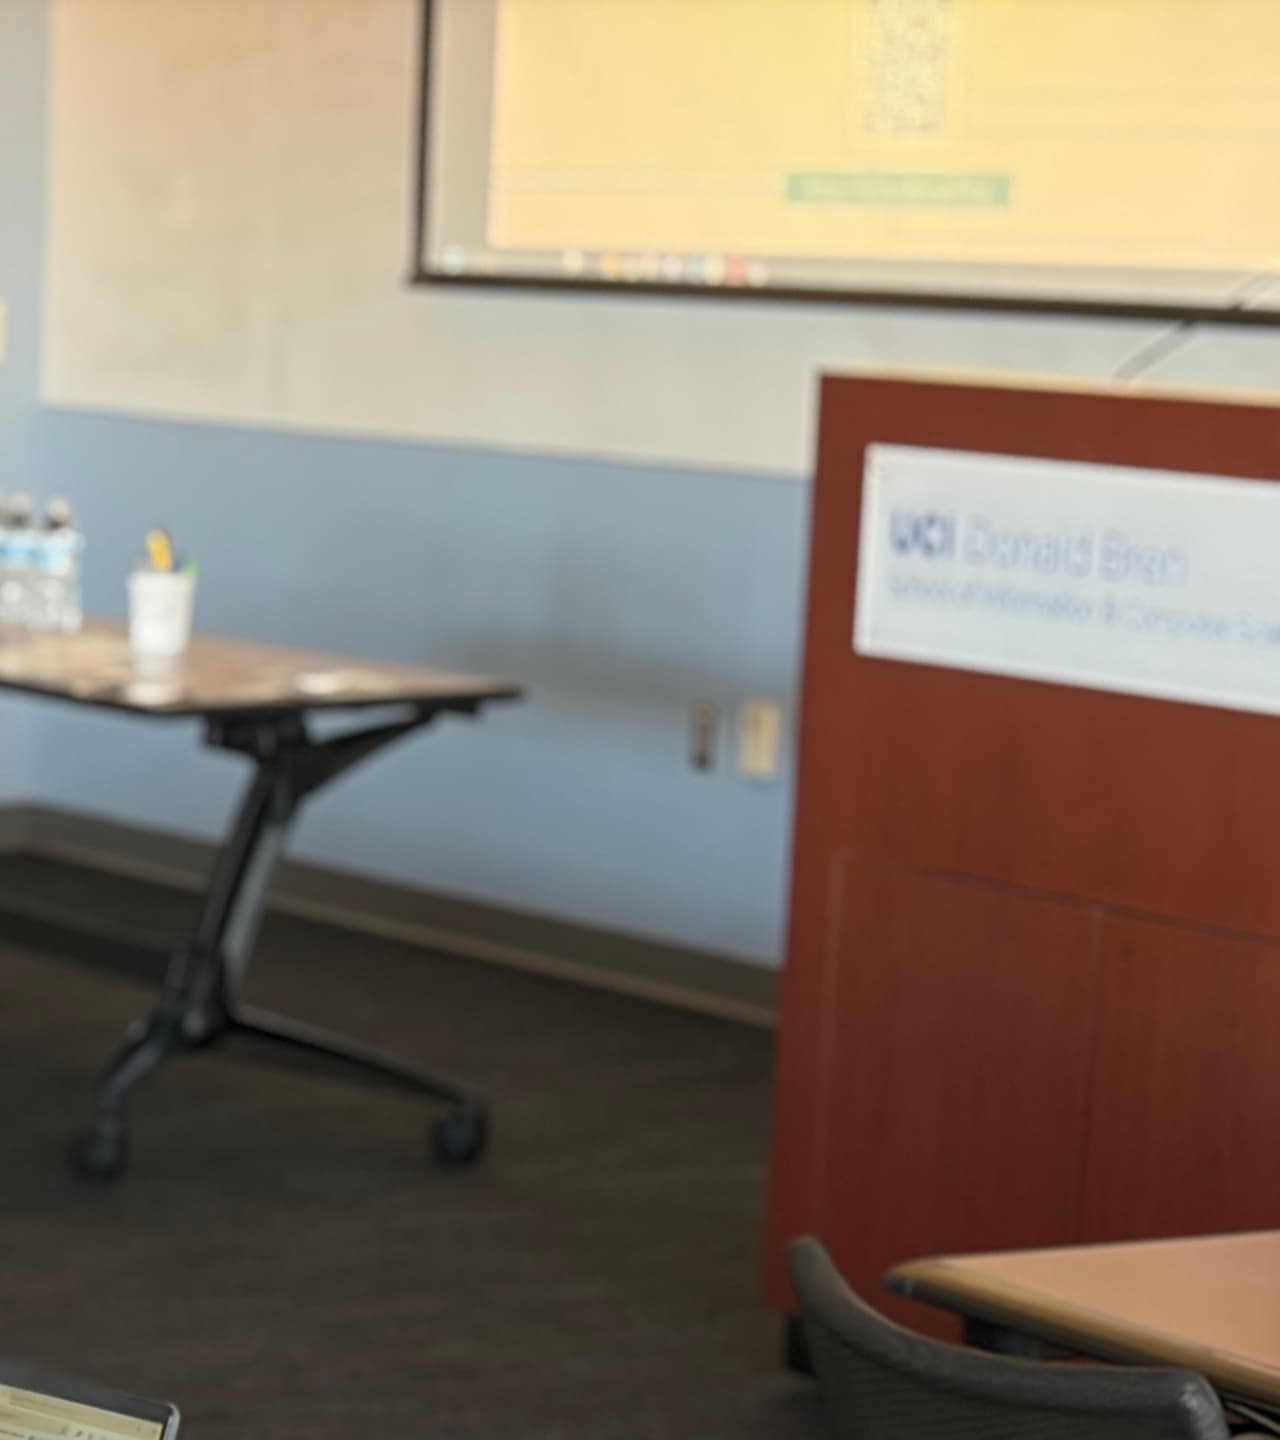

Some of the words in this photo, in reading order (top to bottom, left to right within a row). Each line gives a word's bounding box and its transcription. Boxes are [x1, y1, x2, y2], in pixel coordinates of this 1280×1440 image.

[890, 509, 955, 558] UCI
[965, 514, 1093, 578] Donald
[1098, 529, 1188, 588] Bren
